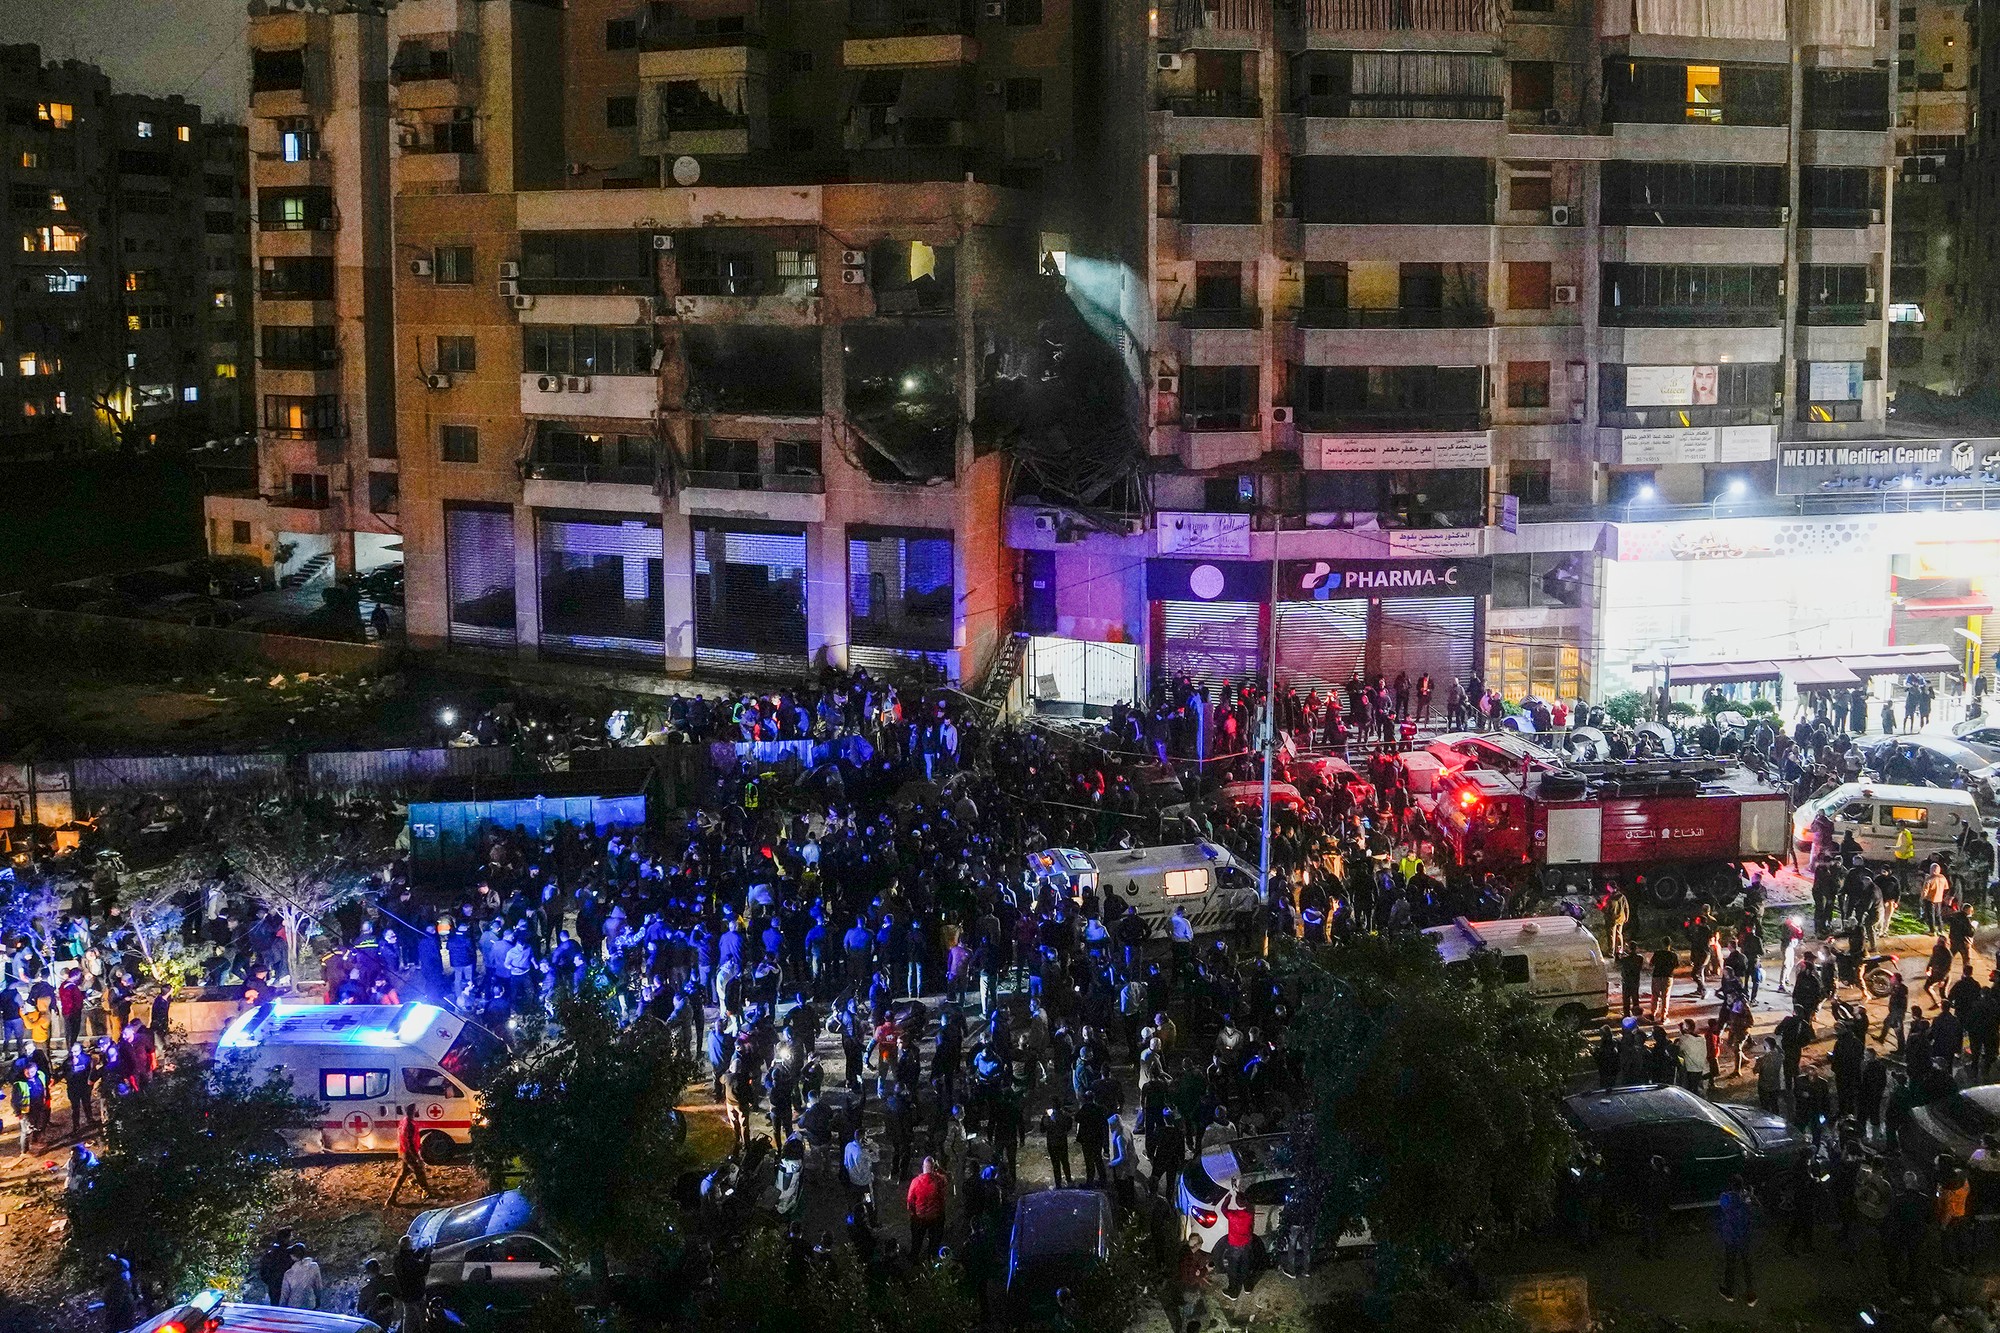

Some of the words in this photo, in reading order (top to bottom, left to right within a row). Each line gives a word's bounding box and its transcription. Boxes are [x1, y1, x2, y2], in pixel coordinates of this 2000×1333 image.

[1783, 447, 1834, 467] MEDEX
[1836, 447, 1893, 466] Medical
[1895, 446, 1943, 465] Center
[1345, 567, 1458, 588] PHARMA-C
